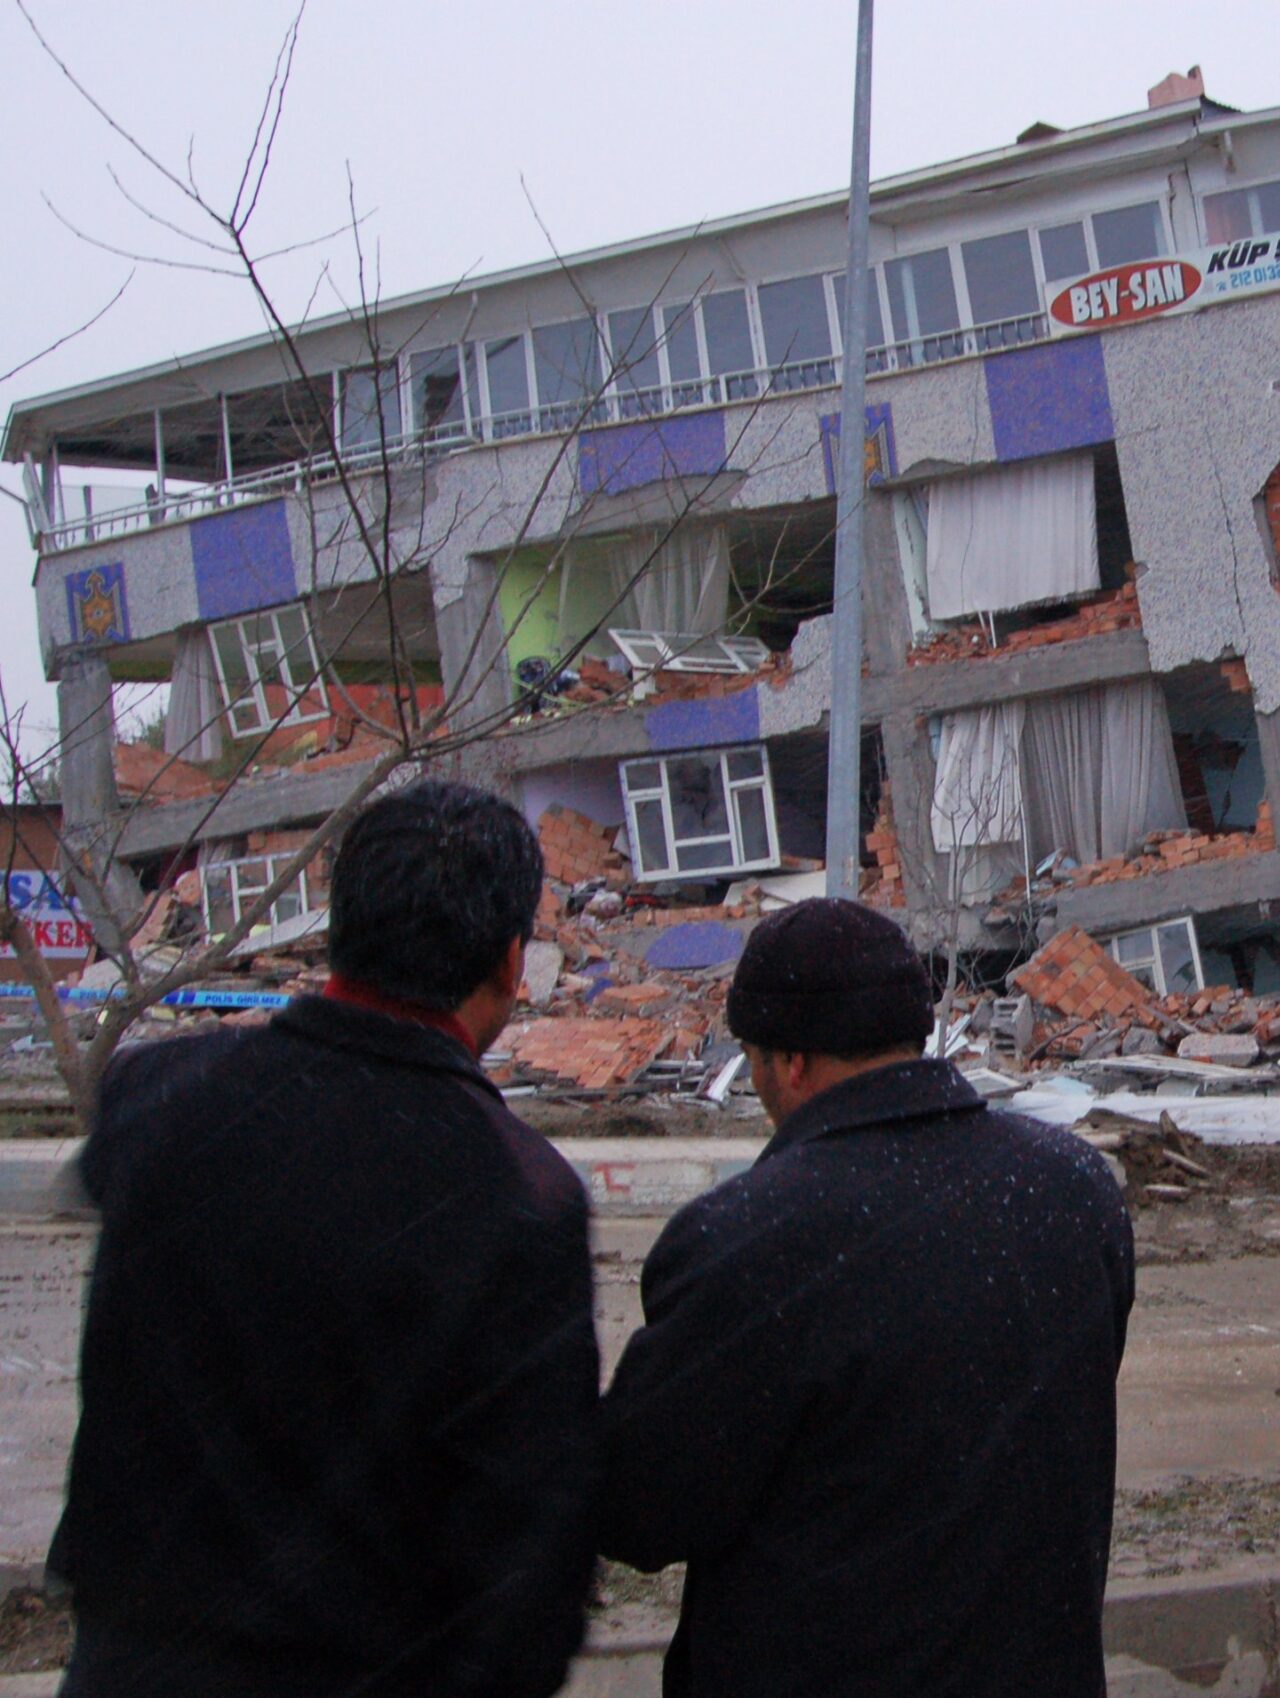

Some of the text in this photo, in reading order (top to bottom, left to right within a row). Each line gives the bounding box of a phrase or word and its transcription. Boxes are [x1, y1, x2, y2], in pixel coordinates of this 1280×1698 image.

[1207, 240, 1270, 274] KÜP
[1070, 263, 1185, 324] BEY-SAN
[1230, 270, 1252, 289] 212
[0, 873, 76, 911] SA
